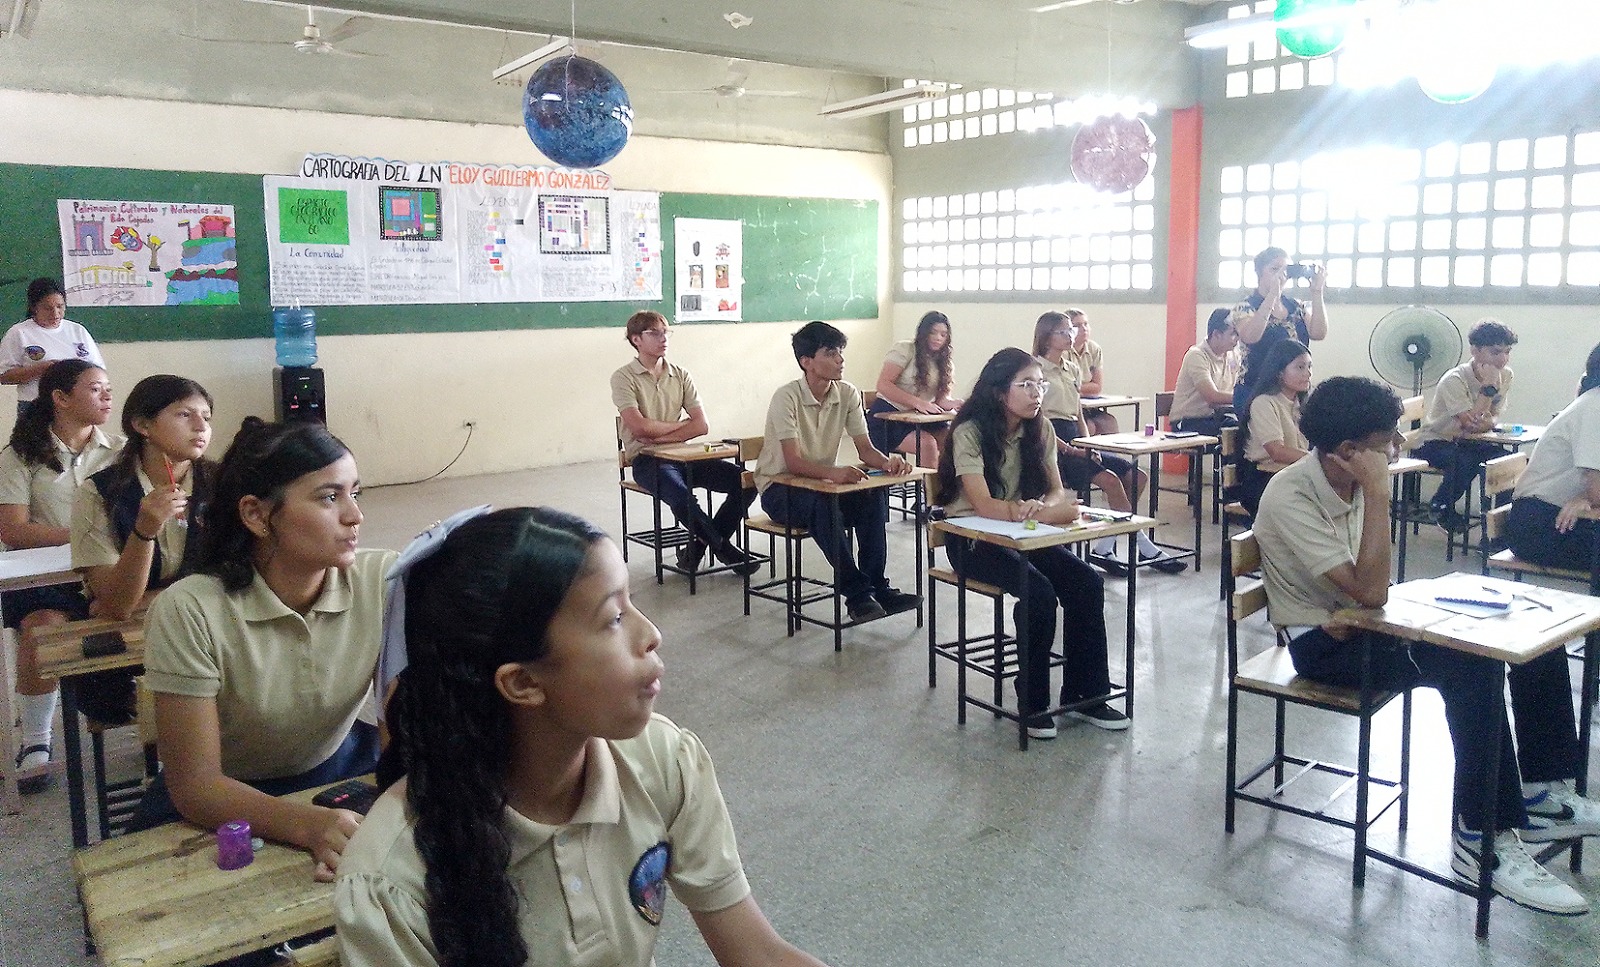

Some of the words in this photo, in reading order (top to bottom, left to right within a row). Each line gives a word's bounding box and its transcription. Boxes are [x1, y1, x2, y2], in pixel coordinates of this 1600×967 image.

[303, 157, 380, 181] CARTOGRAFIA
[384, 164, 410, 182] DEL
[483, 168, 545, 187] GUILLERMO
[290, 246, 301, 257] La
